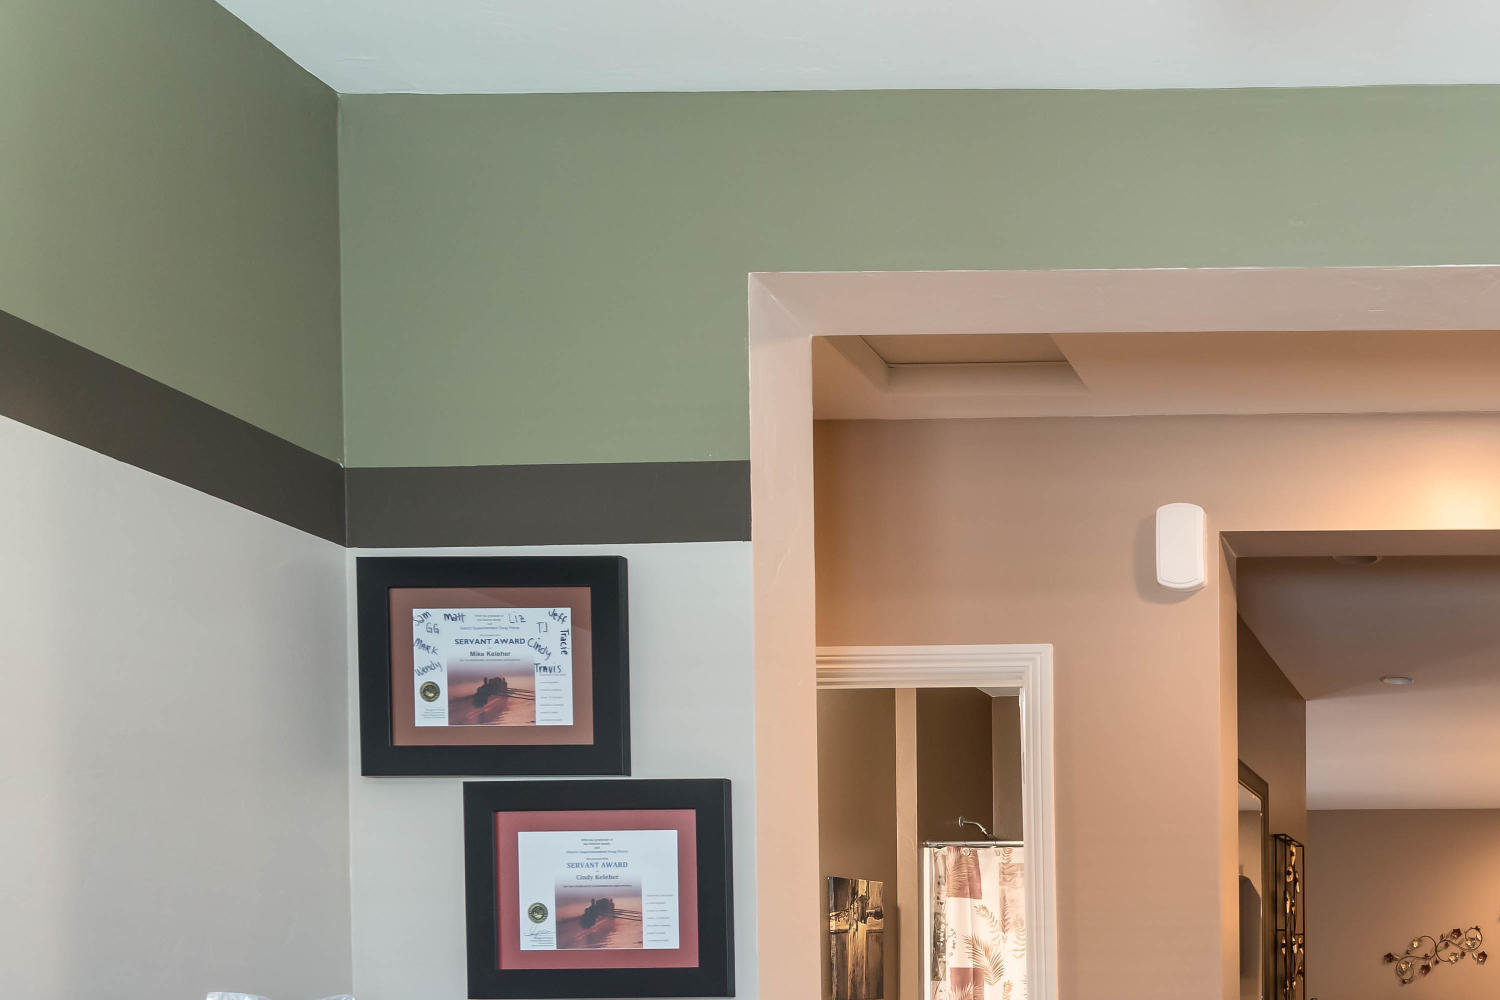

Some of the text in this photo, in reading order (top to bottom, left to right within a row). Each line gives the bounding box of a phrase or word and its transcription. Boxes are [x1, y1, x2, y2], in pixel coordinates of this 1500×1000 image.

[413, 611, 431, 626] Sam
[444, 612, 466, 623] Matt
[548, 609, 568, 624] Jeff
[527, 637, 552, 661] Cindy
[560, 628, 570, 656] Tracie
